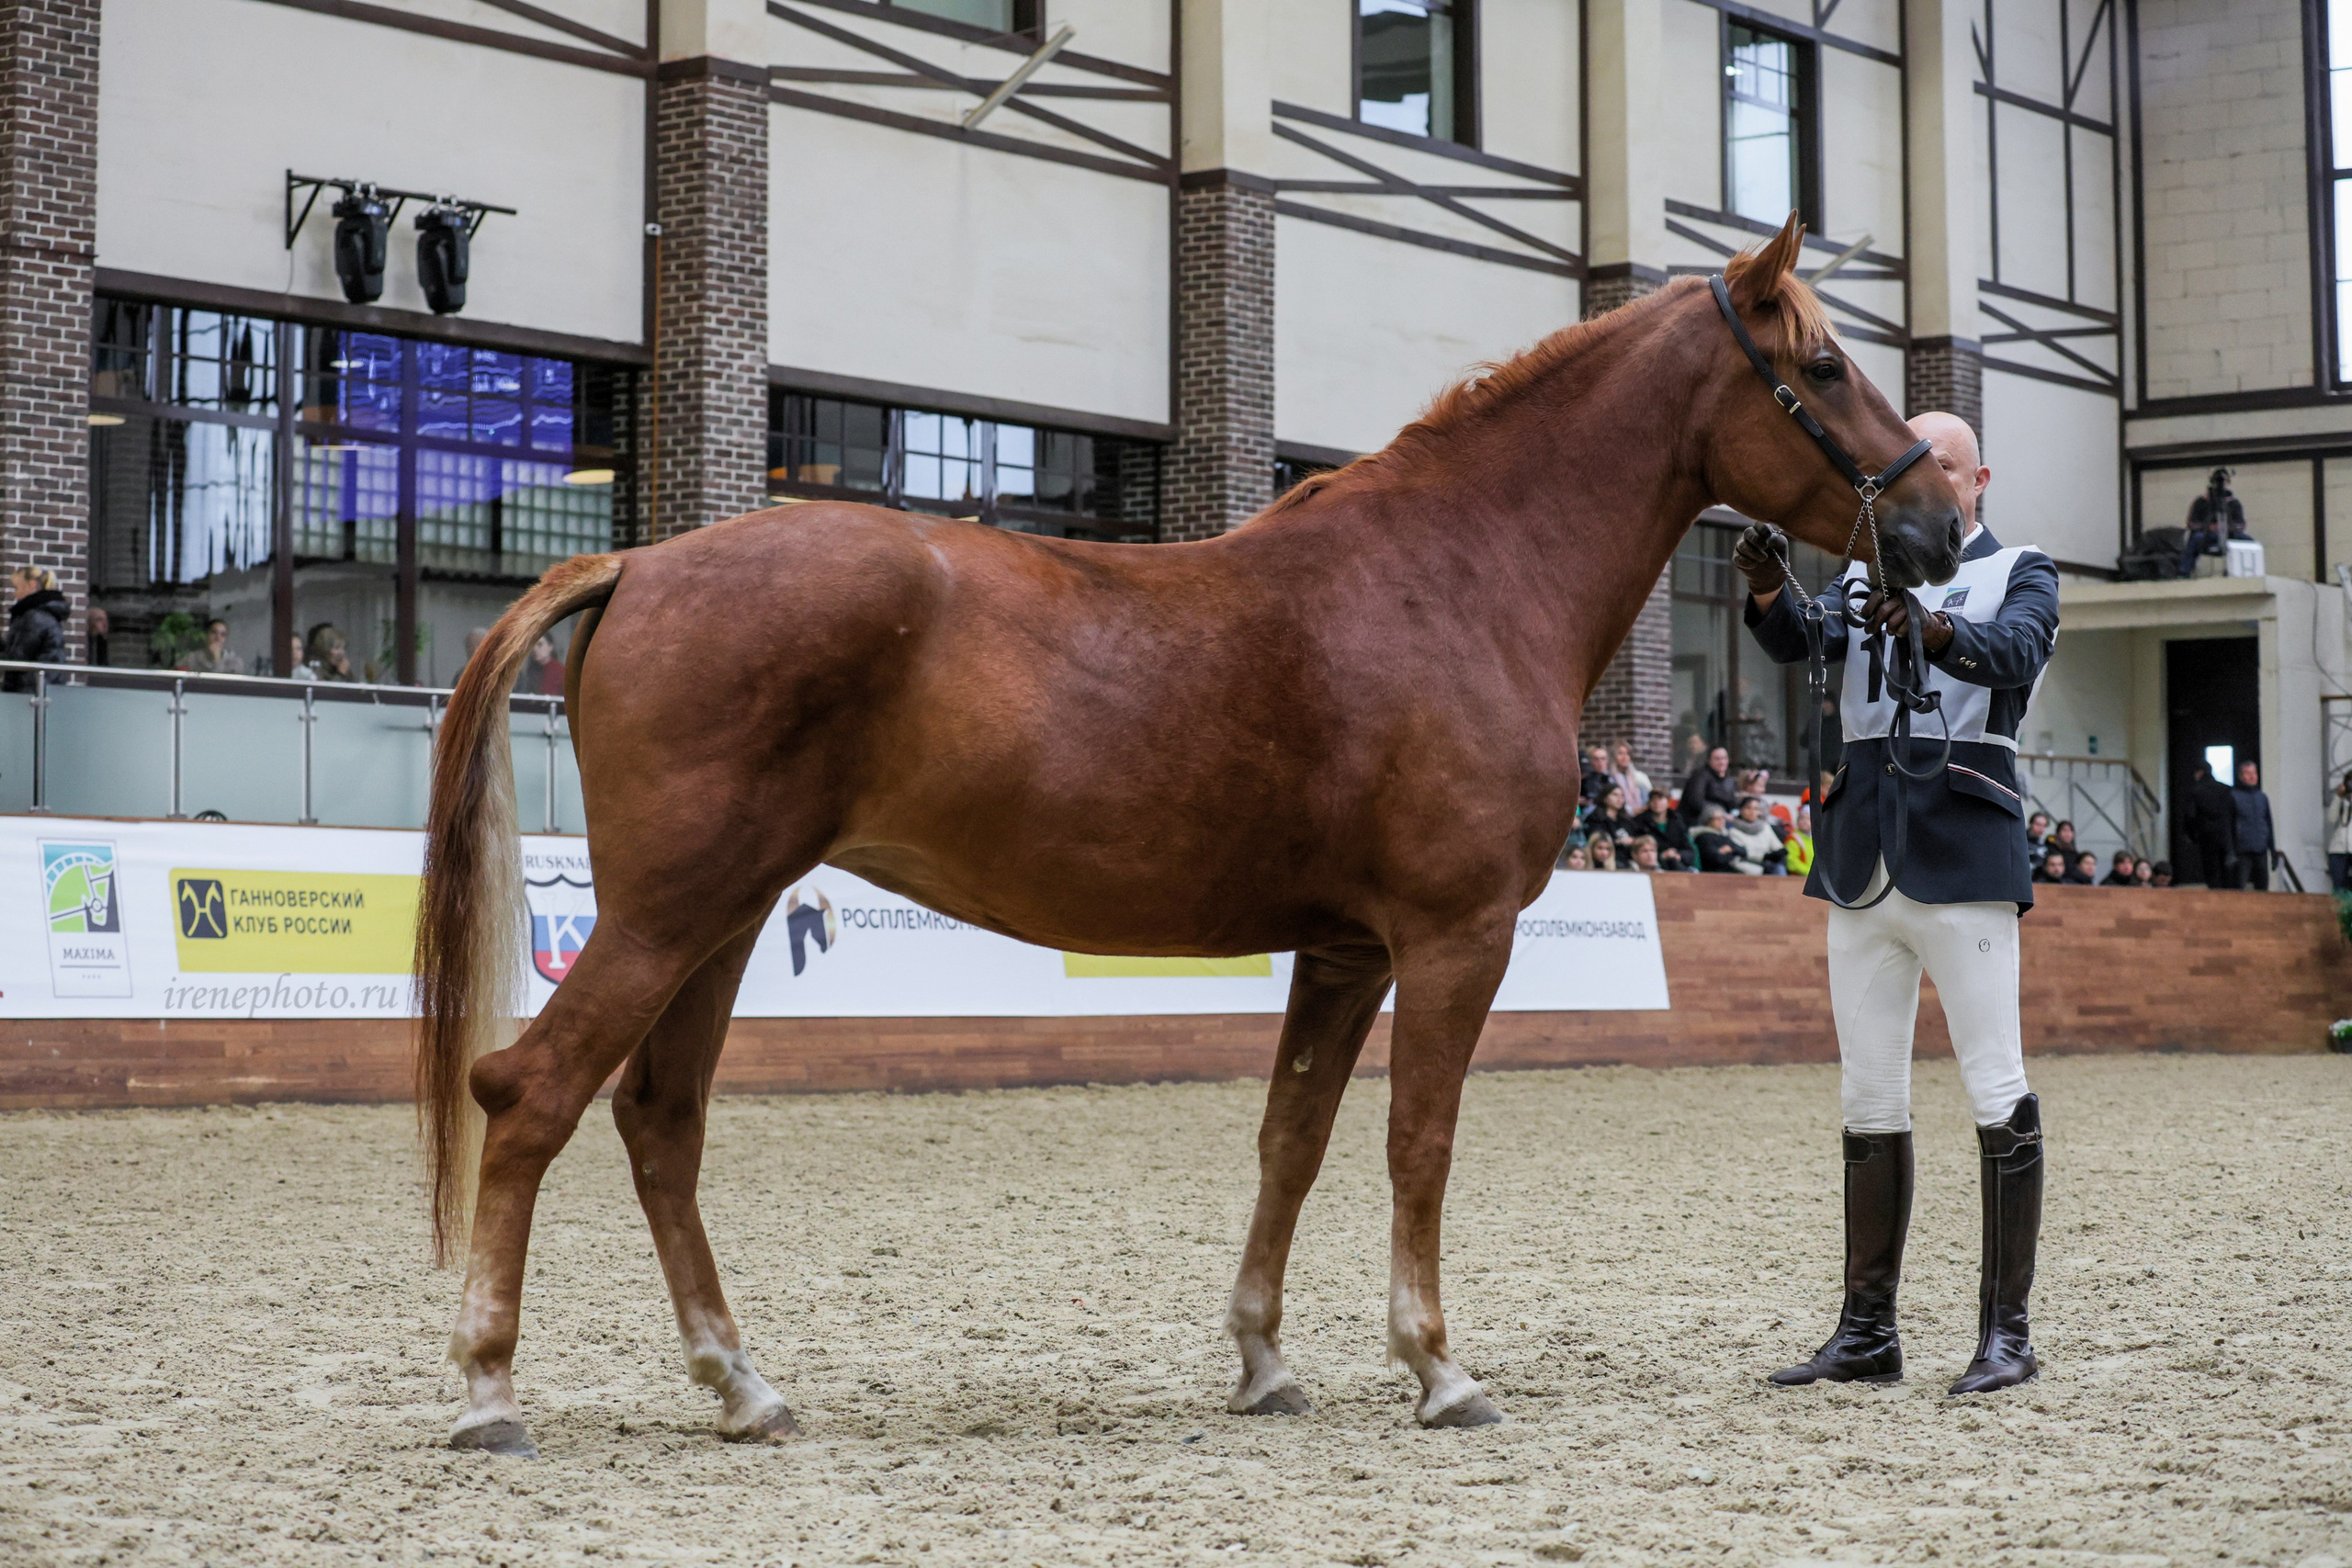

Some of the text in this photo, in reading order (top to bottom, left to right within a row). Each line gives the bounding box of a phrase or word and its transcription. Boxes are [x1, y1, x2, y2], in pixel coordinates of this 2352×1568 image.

[230, 889, 365, 908] ГАННОВЕРСКИЙ
[233, 917, 353, 934] КЛУБ РОССИИ
[62, 948, 116, 961] MAXIMA
